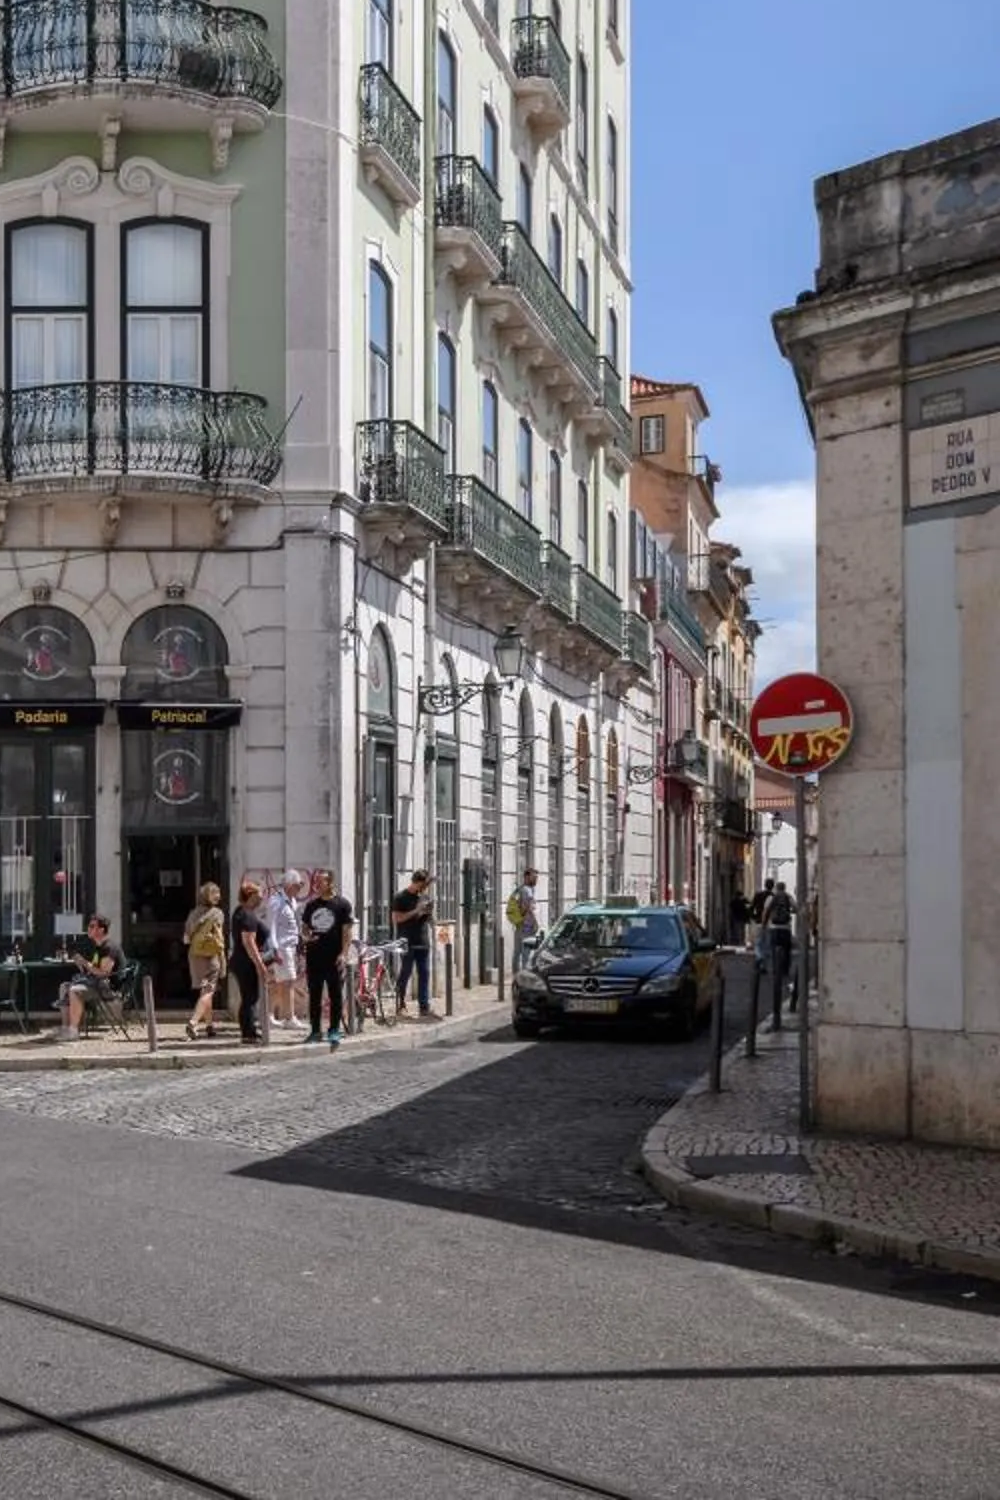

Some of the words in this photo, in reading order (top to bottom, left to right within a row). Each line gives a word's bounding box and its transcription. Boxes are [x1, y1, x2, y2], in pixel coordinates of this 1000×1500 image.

[947, 428, 974, 446] RUA
[946, 450, 975, 469] DOM
[932, 470, 977, 495] PEDRO
[981, 466, 991, 485] V
[15, 709, 68, 723] Padaria
